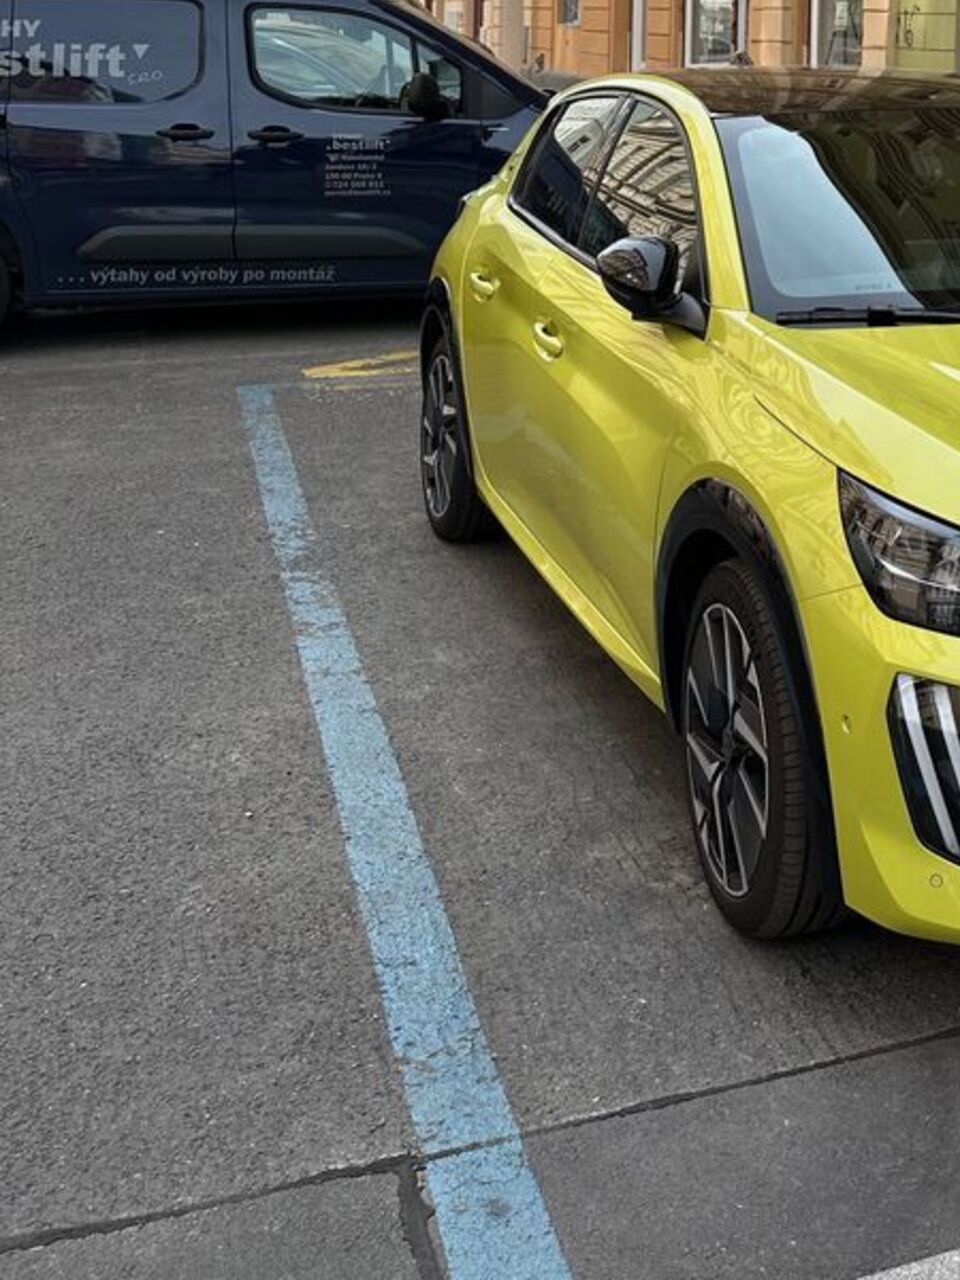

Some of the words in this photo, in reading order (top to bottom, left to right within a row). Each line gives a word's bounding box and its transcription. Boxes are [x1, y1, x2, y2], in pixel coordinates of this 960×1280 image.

[90, 265, 149, 286] výtahy
[154, 267, 176, 281] od
[182, 265, 239, 285] výroby
[243, 270, 265, 284] po
